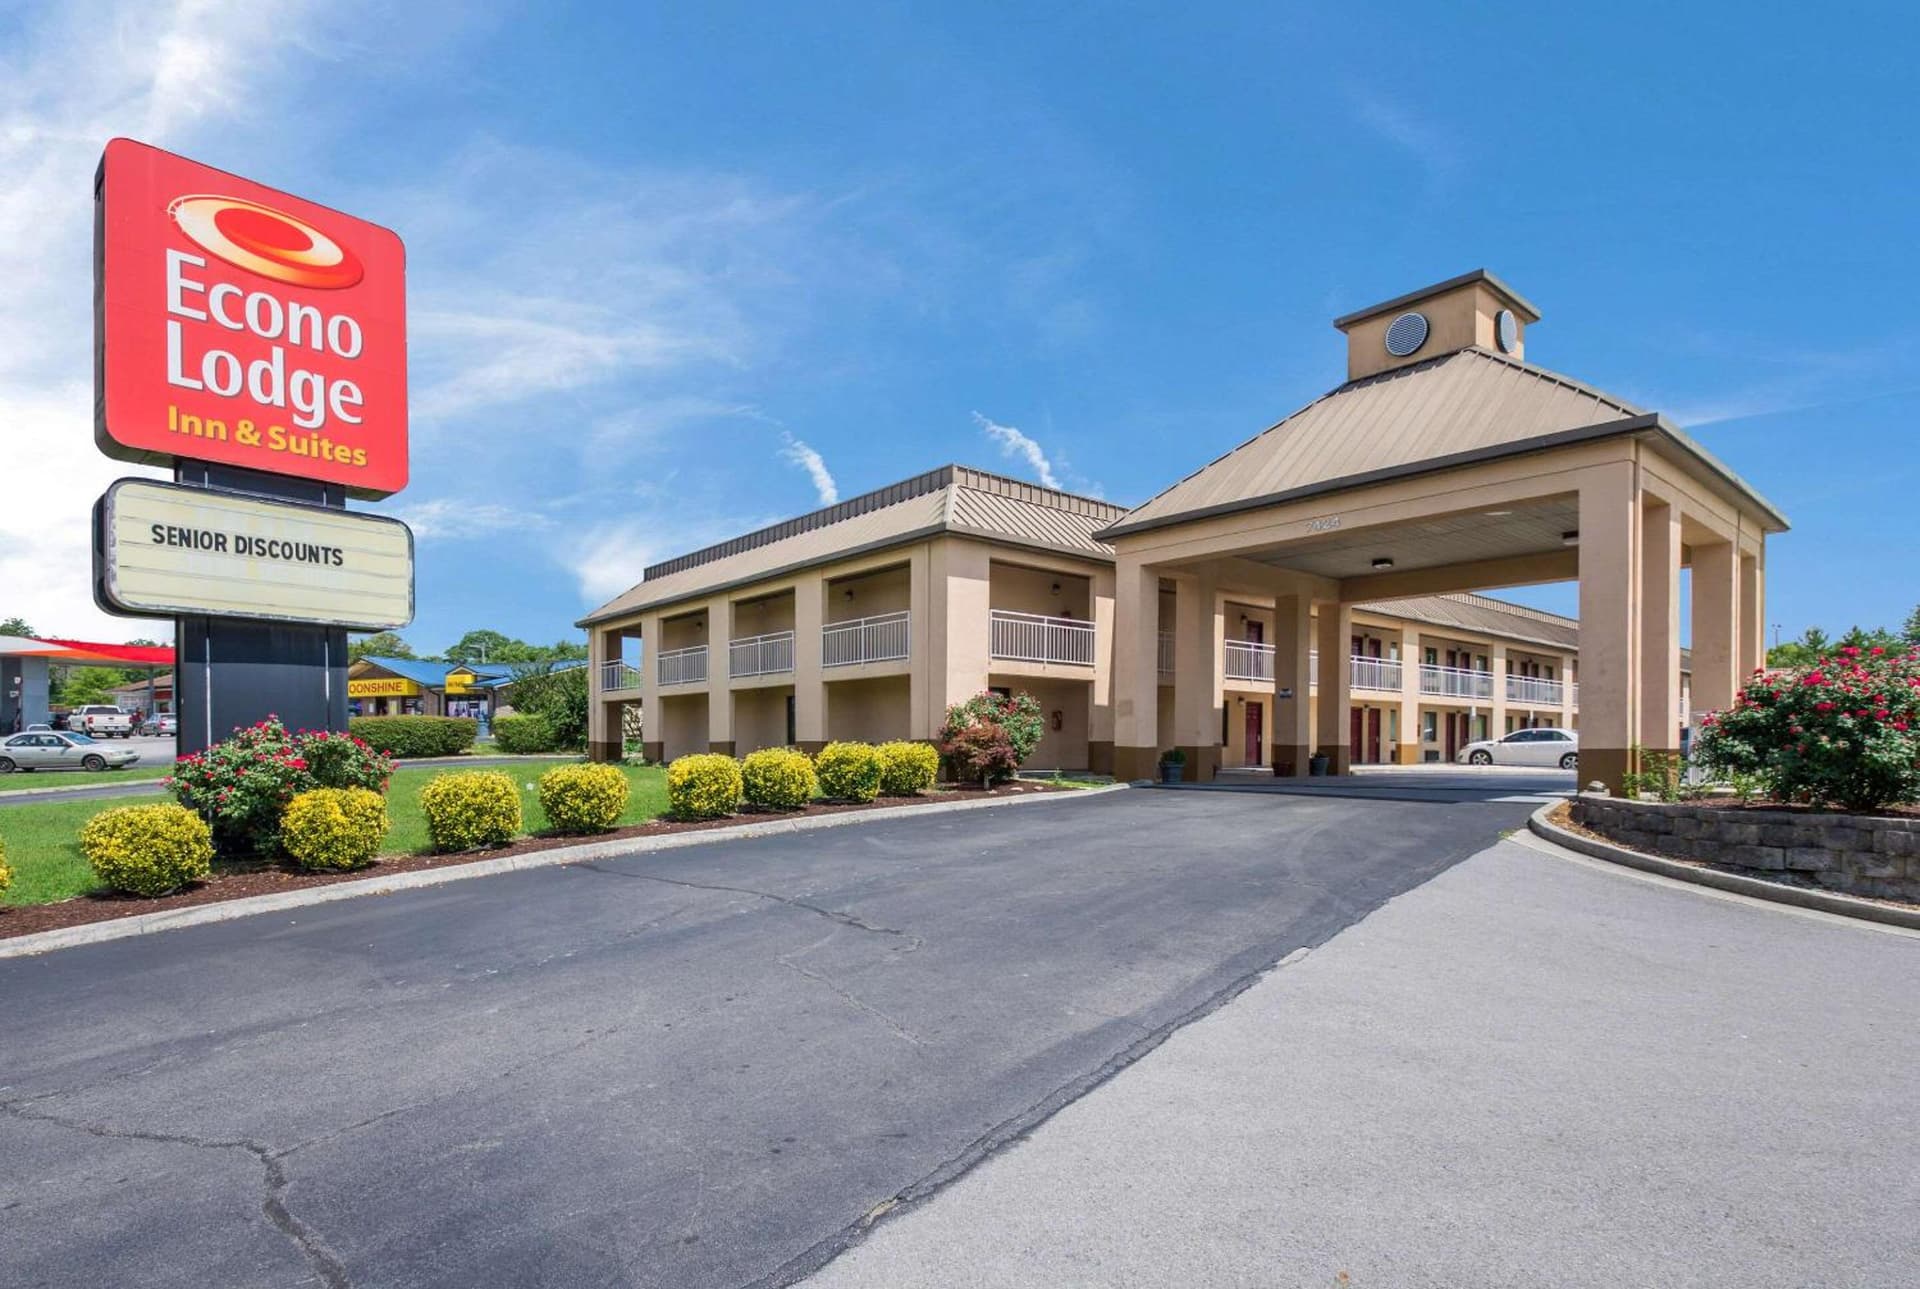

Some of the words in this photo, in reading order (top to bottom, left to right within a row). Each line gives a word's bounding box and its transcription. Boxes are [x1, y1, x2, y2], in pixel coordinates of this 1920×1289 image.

[166, 248, 363, 359] Econo
[166, 320, 363, 429] Lodge
[168, 405, 228, 441] Inn
[235, 419, 261, 447] &
[267, 425, 368, 466] Suites
[151, 524, 228, 552] SENIOR
[234, 535, 344, 566] DISCOUNTS
[349, 681, 403, 694] OONSHINE
